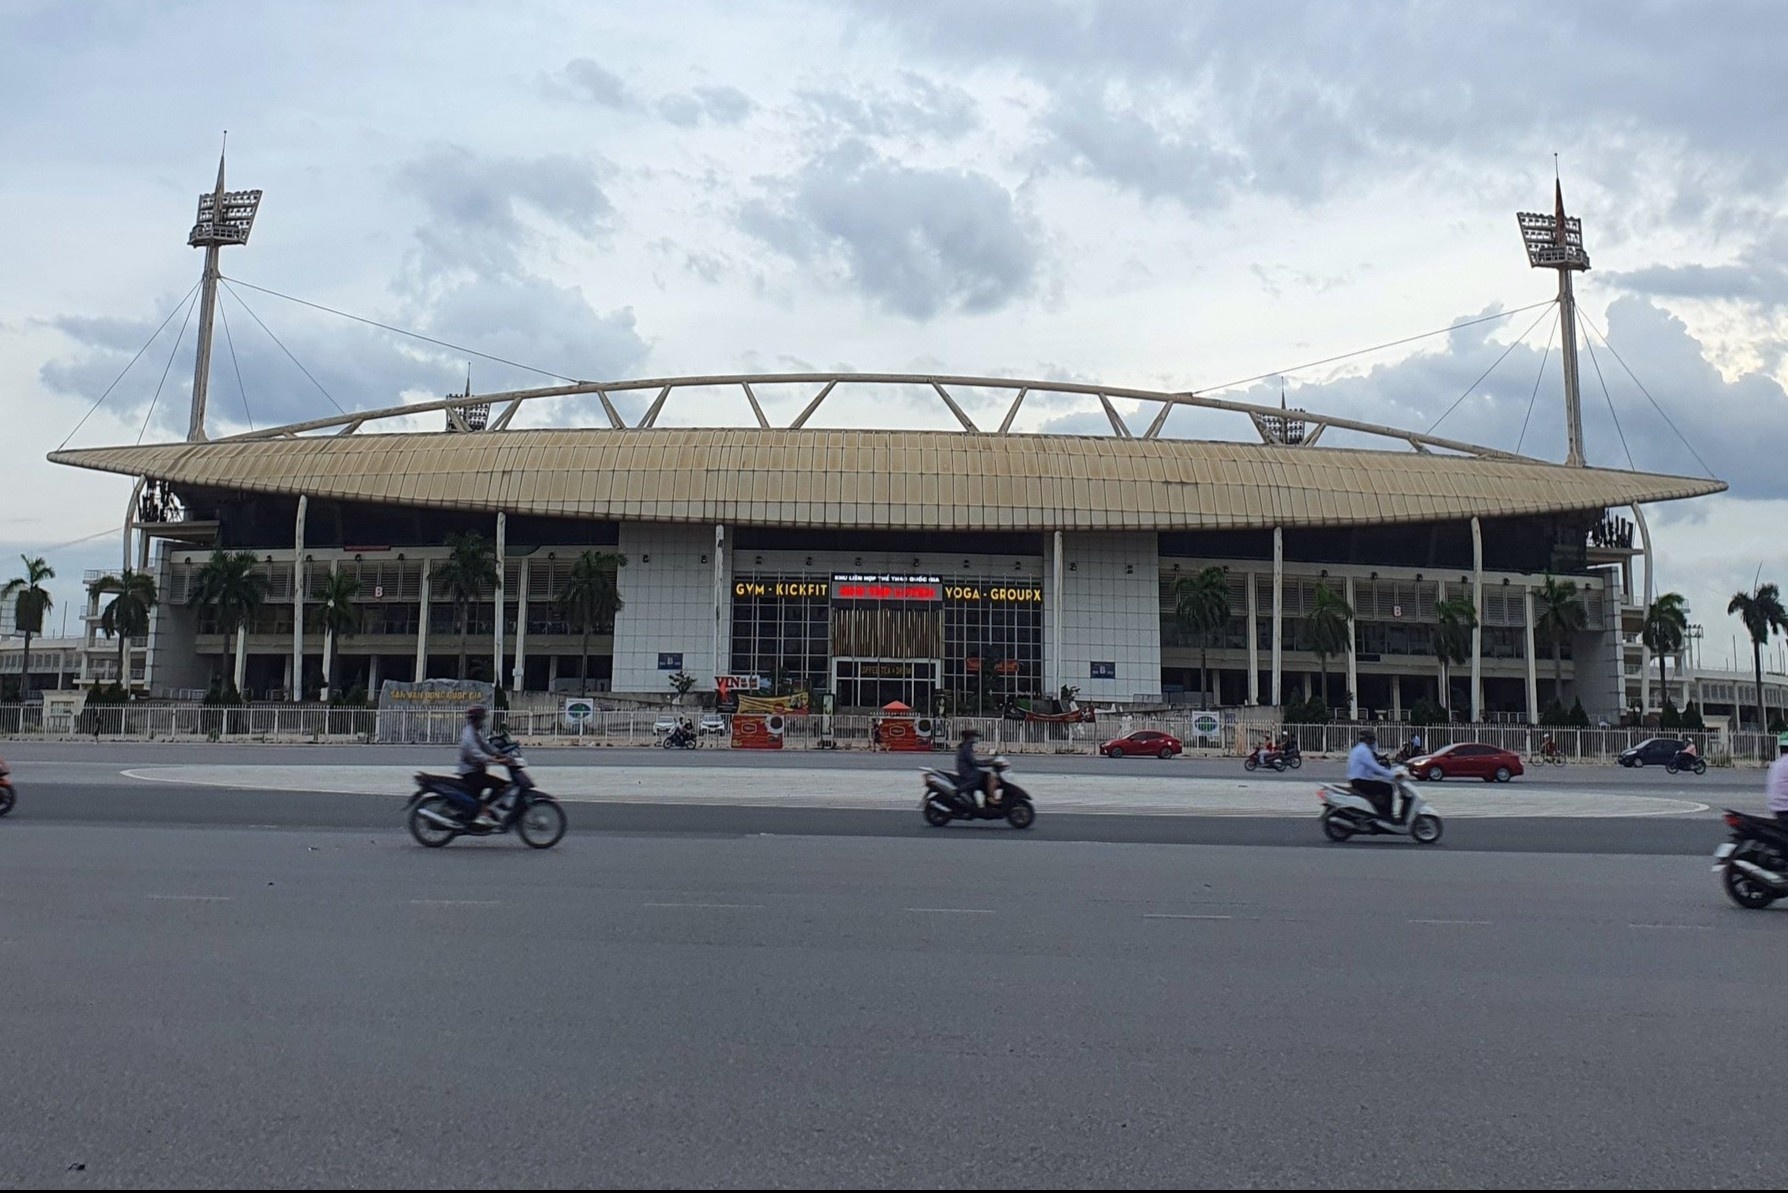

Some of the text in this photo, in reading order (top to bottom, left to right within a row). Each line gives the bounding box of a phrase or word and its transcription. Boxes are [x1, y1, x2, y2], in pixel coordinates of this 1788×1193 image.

[375, 586, 383, 597] B
[736, 583, 766, 596] GYM
[776, 583, 828, 597] KICKFIT
[945, 587, 981, 600] YOGA
[990, 588, 1042, 602] GROUPX
[1393, 605, 1402, 617] B
